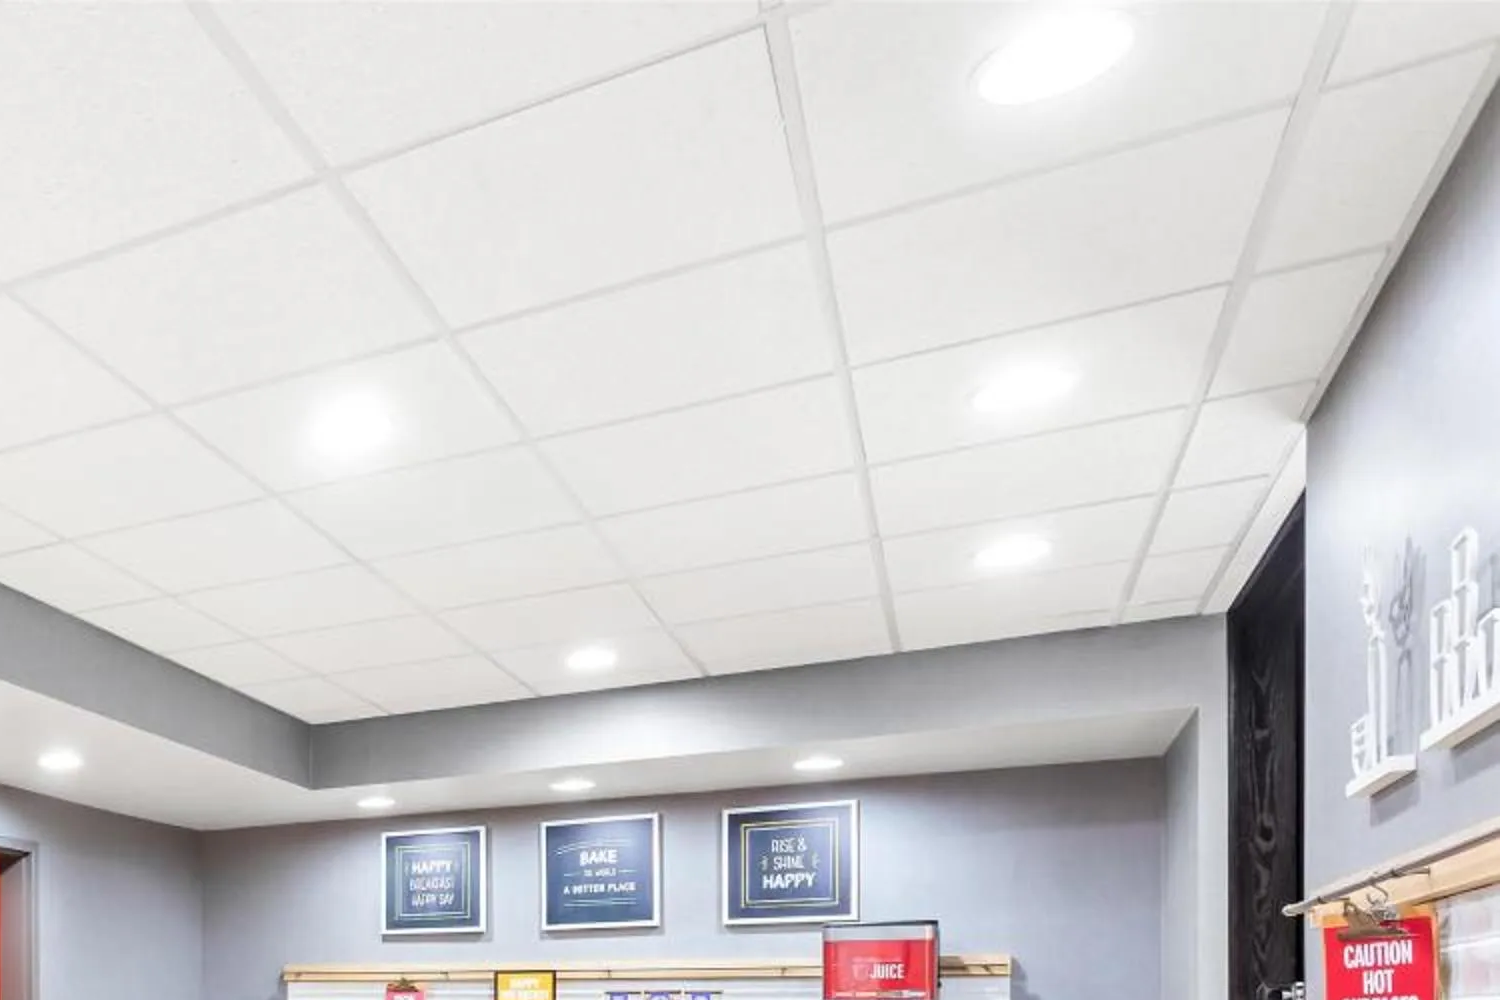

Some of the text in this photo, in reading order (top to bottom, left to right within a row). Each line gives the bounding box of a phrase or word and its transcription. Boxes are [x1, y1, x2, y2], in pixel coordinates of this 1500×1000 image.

[771, 838, 796, 853] RISE
[580, 848, 618, 866] BAKE
[411, 860, 453, 874] HAPPY
[607, 881, 637, 893] PLACE
[763, 872, 816, 889] HAPPY
[1344, 940, 1413, 969] CAUTION
[869, 963, 905, 979] JUICE
[1363, 969, 1394, 994] HOT
